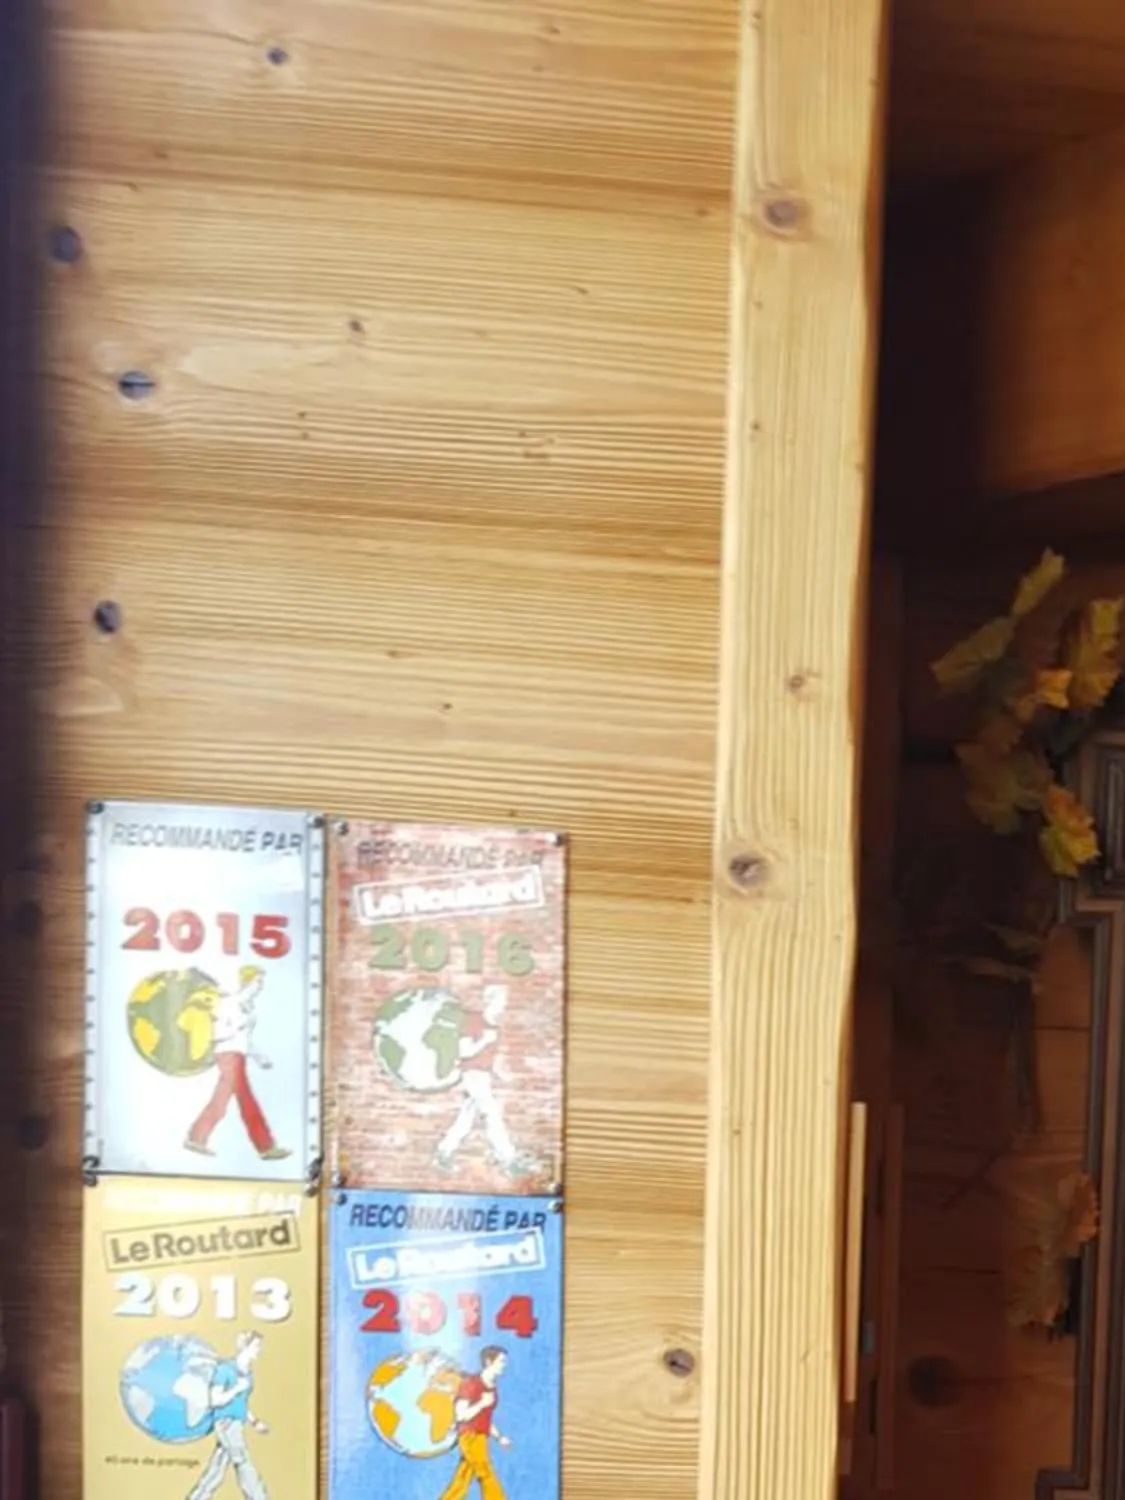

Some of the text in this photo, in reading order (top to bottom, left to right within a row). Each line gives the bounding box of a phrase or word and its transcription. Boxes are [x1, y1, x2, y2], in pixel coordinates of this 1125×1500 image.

[260, 831, 304, 856] PAR
[121, 907, 292, 959] 2015
[368, 922, 536, 977] 2016
[110, 1218, 291, 1265] Le Routard
[503, 1210, 547, 1233] PAR
[113, 1271, 293, 1325] 2013
[359, 1288, 539, 1338] 2014
